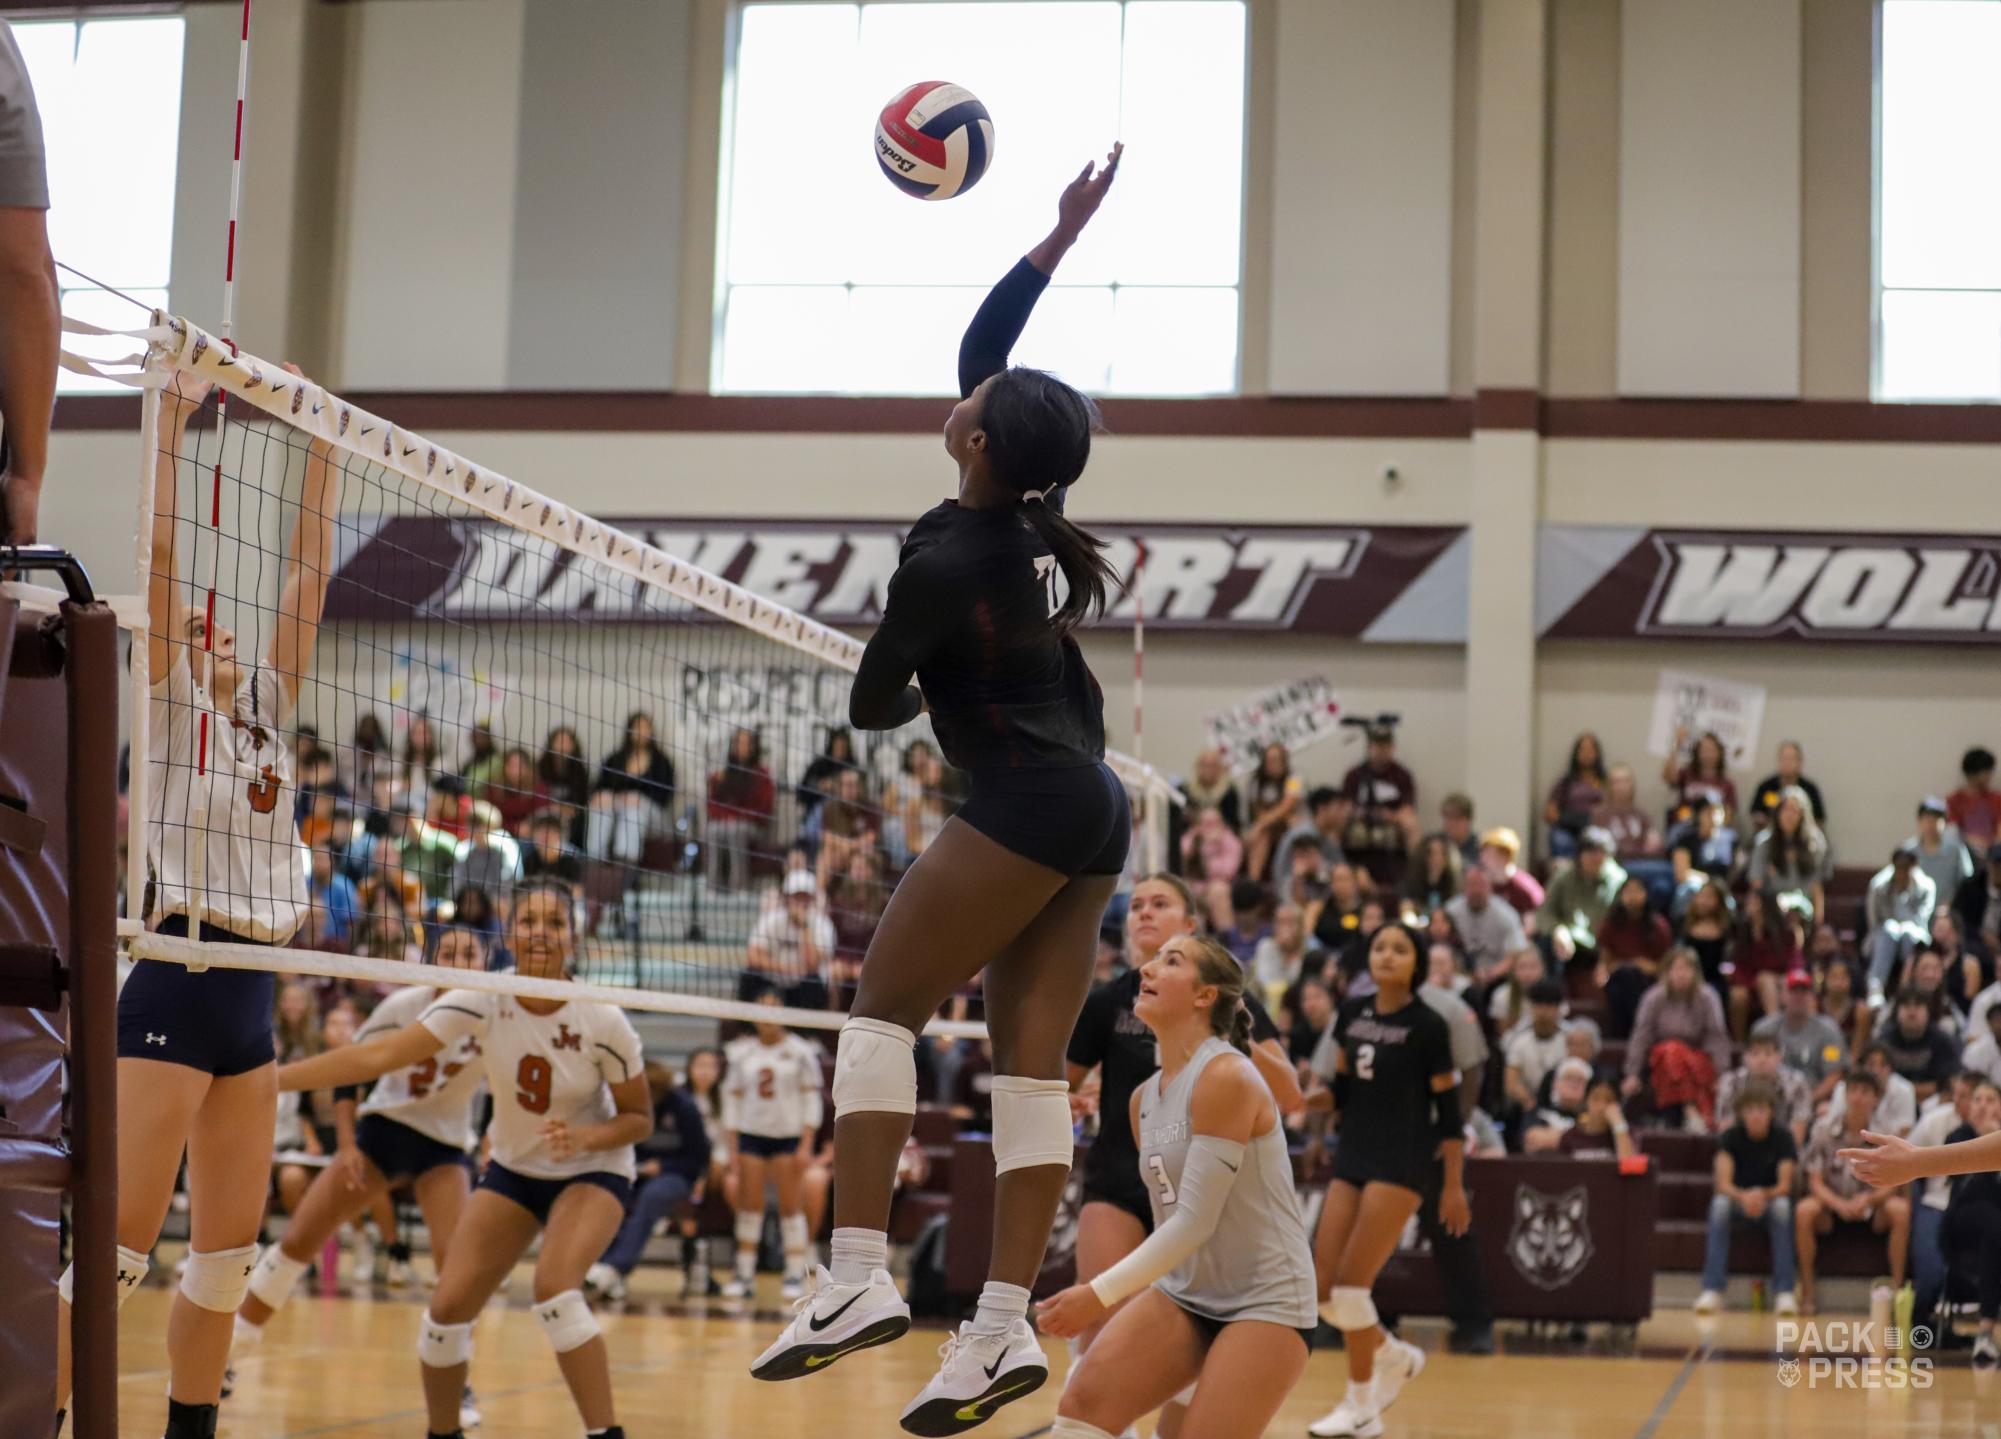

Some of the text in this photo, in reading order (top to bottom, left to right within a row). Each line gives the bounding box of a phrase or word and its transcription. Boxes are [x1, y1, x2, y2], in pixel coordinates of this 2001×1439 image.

[877, 135, 917, 173] Baden
[432, 528, 1352, 622] DAVENRT
[1656, 543, 2001, 632] WOL
[682, 664, 850, 722] RESPEC
[516, 1054, 553, 1116] 9
[757, 1067, 775, 1101] 2
[1356, 1043, 1376, 1080] 2
[1149, 1153, 1178, 1205] 3
